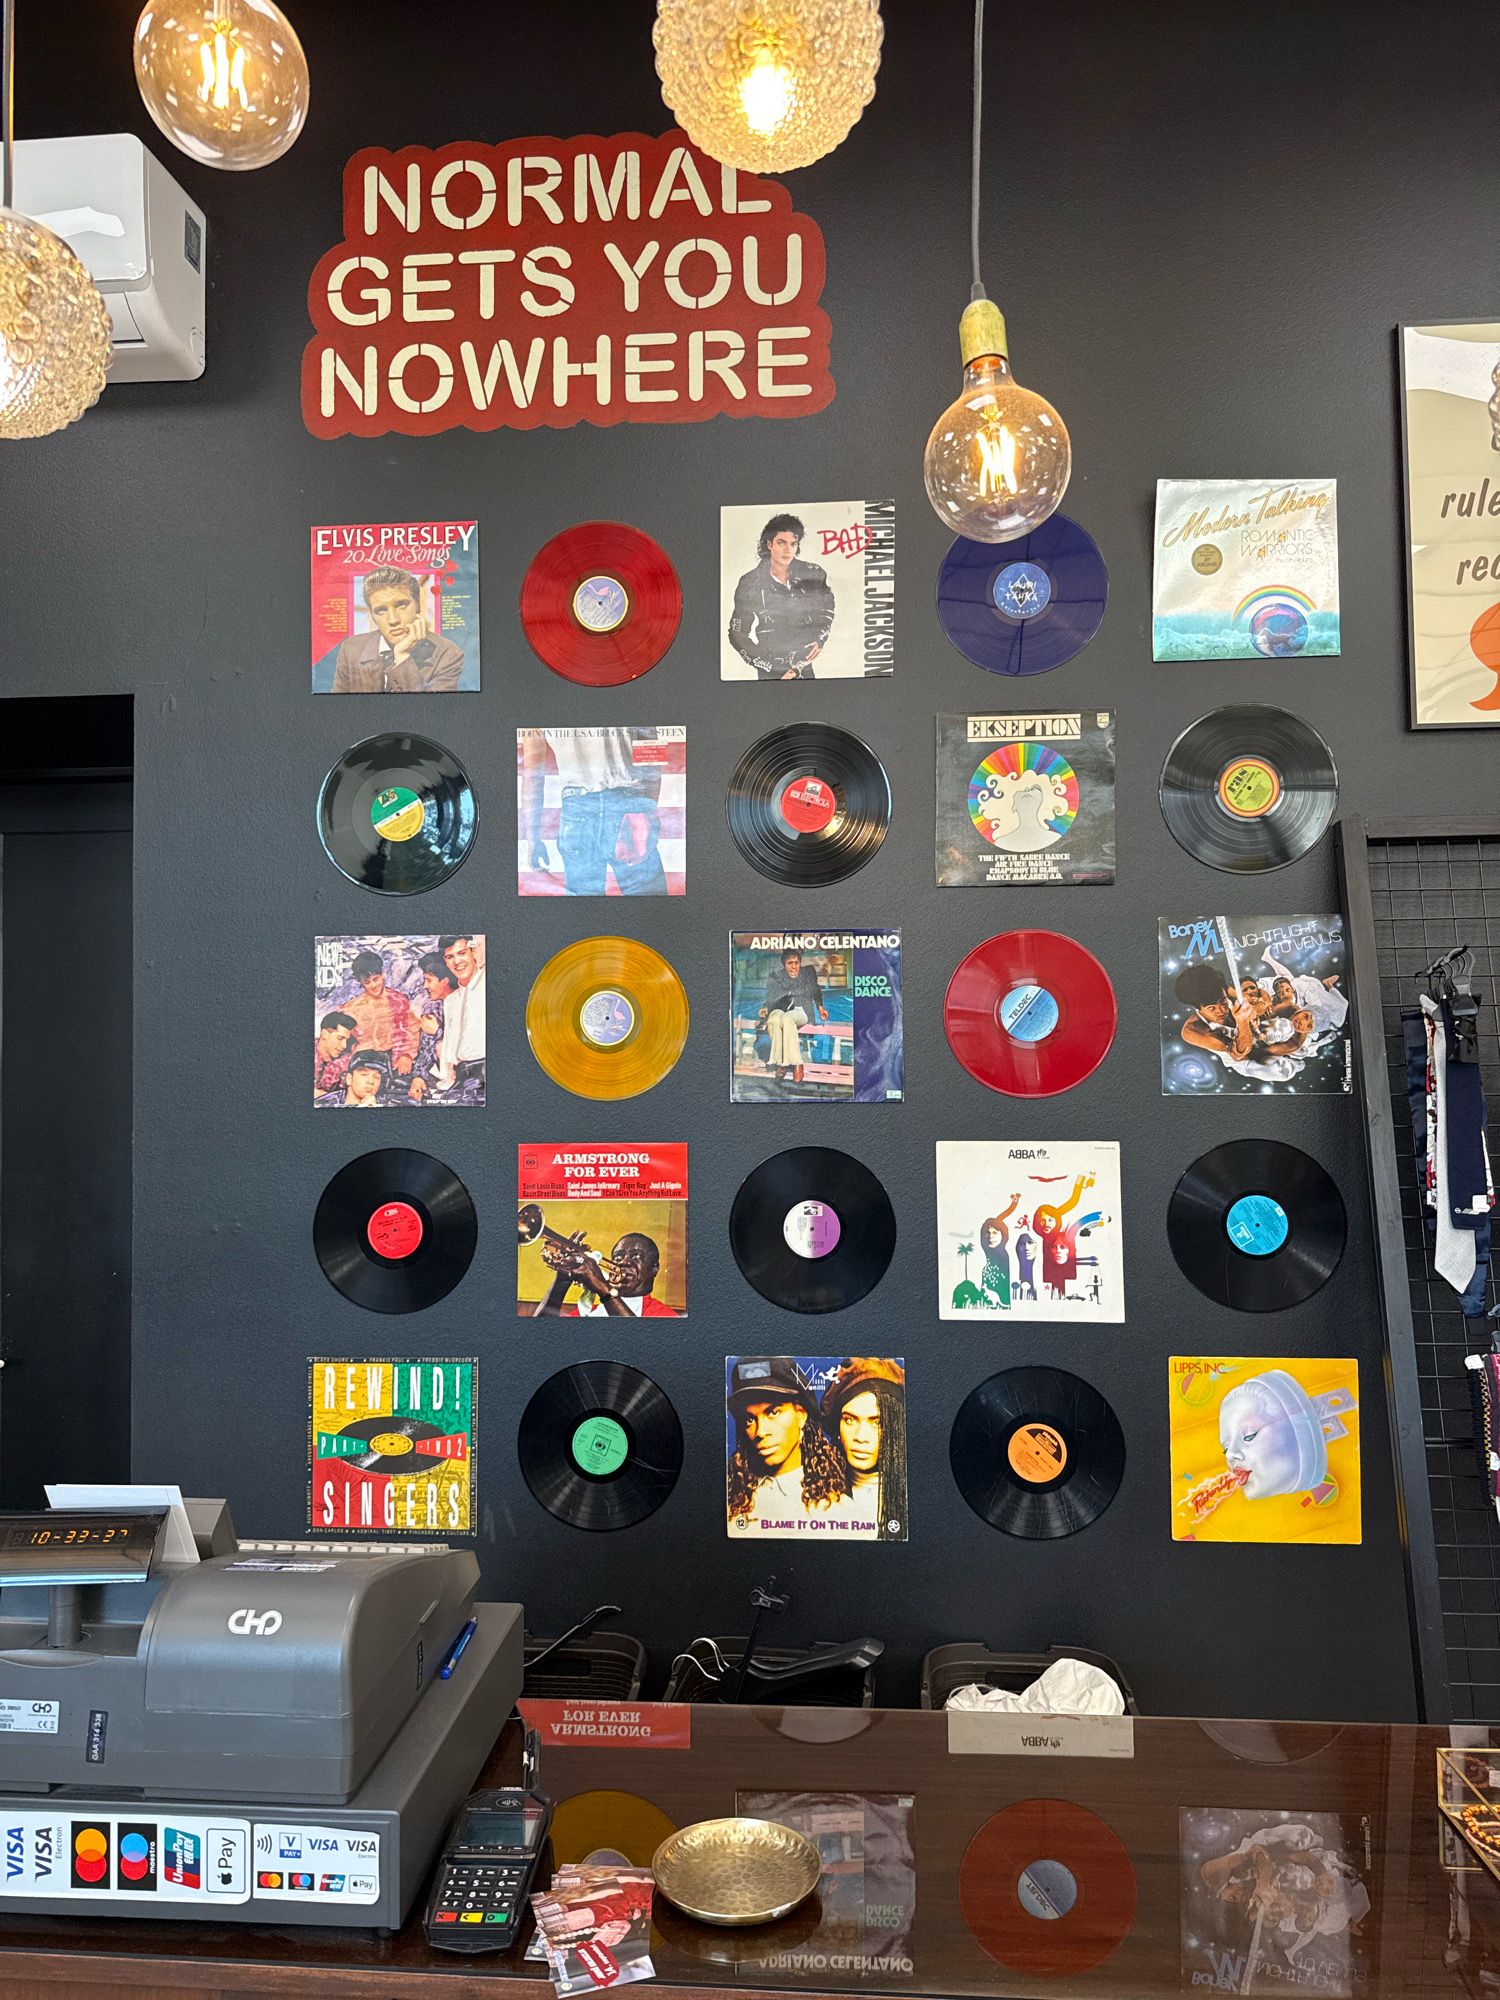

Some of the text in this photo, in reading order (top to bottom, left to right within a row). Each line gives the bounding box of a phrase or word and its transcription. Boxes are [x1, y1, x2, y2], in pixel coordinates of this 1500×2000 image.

[364, 147, 772, 235] NORMAL
[327, 233, 802, 326] GETS YOU
[320, 326, 813, 418] NOWHERE
[1162, 483, 1327, 548] Modern Talking
[317, 525, 475, 555] ELVIS PRESLEY
[817, 523, 873, 559] BAD
[864, 500, 895, 587] MICHAEL
[1241, 529, 1314, 543] ROMANTIC
[343, 543, 452, 568] 20 Love Songs
[1241, 543, 1313, 559] WARRIORS
[863, 588, 894, 677] JACKSON
[968, 718, 1081, 738] EKSEPTION
[1168, 919, 1214, 939] Boney
[750, 934, 900, 949] ADRIANO CELENTANO
[1274, 930, 1342, 954] TO VENUS
[855, 975, 888, 987] DISCO
[855, 987, 892, 998] DANCE
[1008, 993, 1032, 1020] TELDEC
[552, 1153, 650, 1164] ARMSTRONG
[1008, 1149, 1036, 1159] ABBA
[564, 1167, 640, 1178] FOR EVER
[324, 1366, 461, 1410] REWIND!
[323, 1480, 460, 1528] SINGERS
[737, 1519, 745, 1527] 12
[93, 1728, 101, 1744] 314
[6, 1826, 24, 1882] VISA
[34, 1826, 63, 1883] VISA Electron
[218, 1836, 236, 1868] Pay
[307, 1838, 339, 1851] VISA
[344, 1839, 377, 1853] VISA
[172, 1832, 187, 1883] UnionPay
[359, 1880, 373, 1889] Pay
